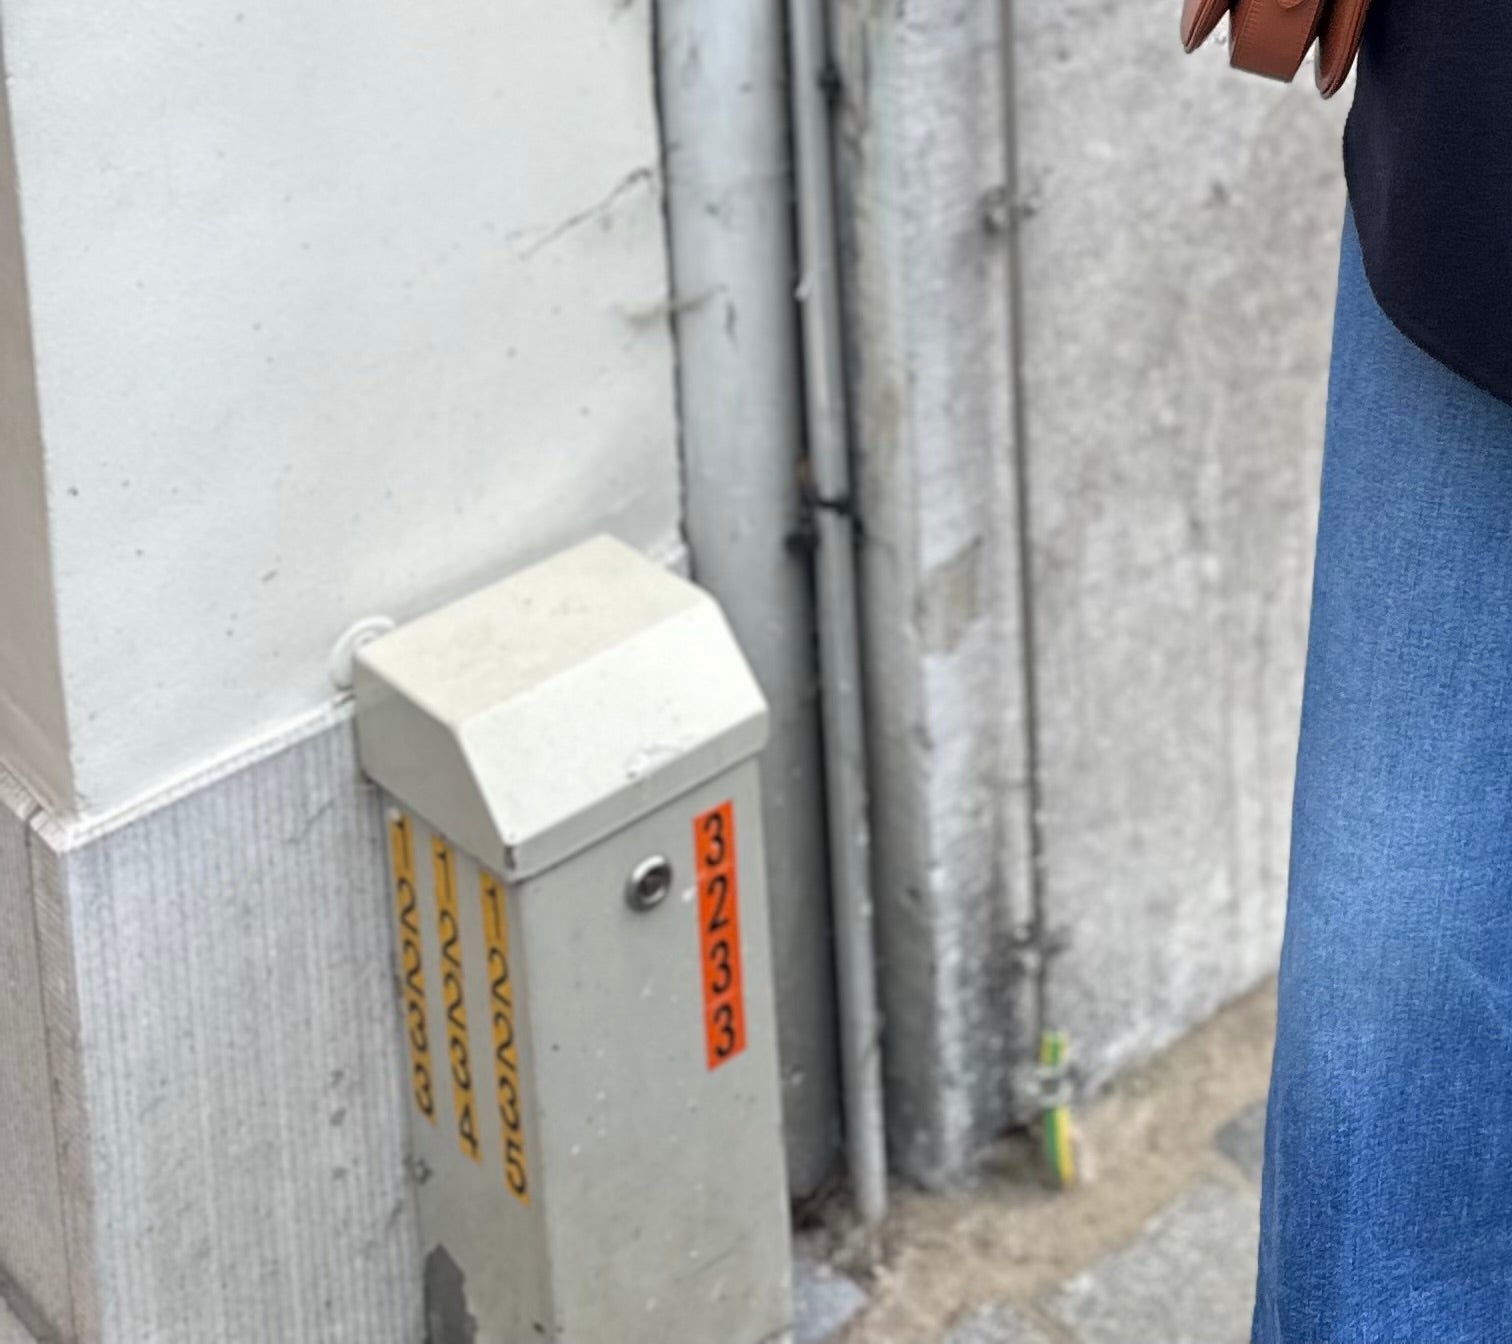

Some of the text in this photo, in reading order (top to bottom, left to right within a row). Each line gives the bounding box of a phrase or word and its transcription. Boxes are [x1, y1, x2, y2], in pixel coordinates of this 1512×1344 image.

[394, 820, 434, 1116] 12233
[436, 849, 477, 1158] 12234
[484, 884, 527, 1194] 12235
[703, 811, 735, 1058] 3233
